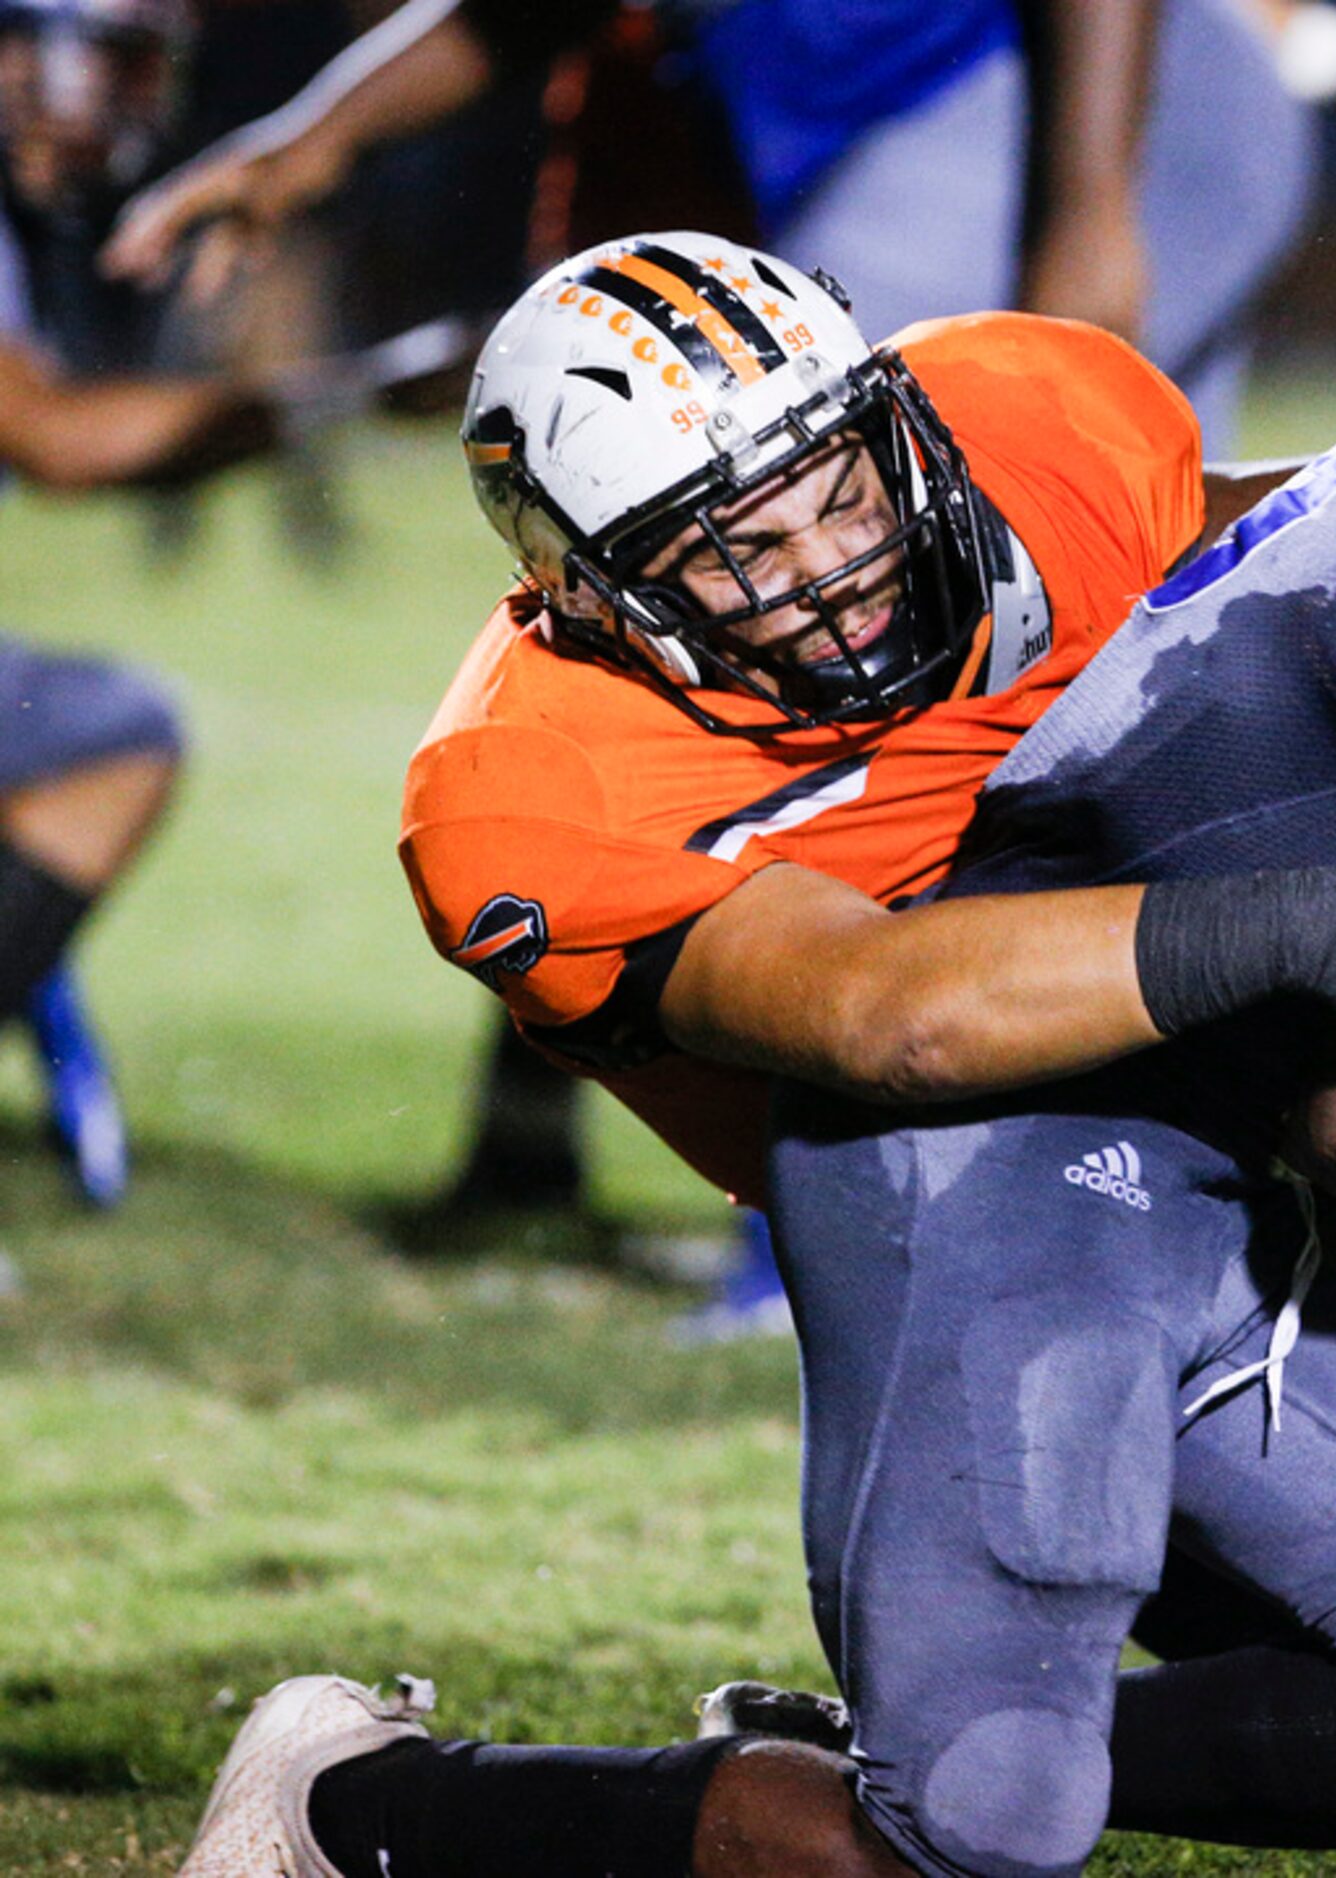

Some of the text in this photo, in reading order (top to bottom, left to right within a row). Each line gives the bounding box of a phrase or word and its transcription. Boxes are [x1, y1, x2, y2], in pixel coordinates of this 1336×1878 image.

[783, 323, 814, 352] 99
[671, 400, 709, 434] 99
[1064, 1165, 1151, 1211] adidas
